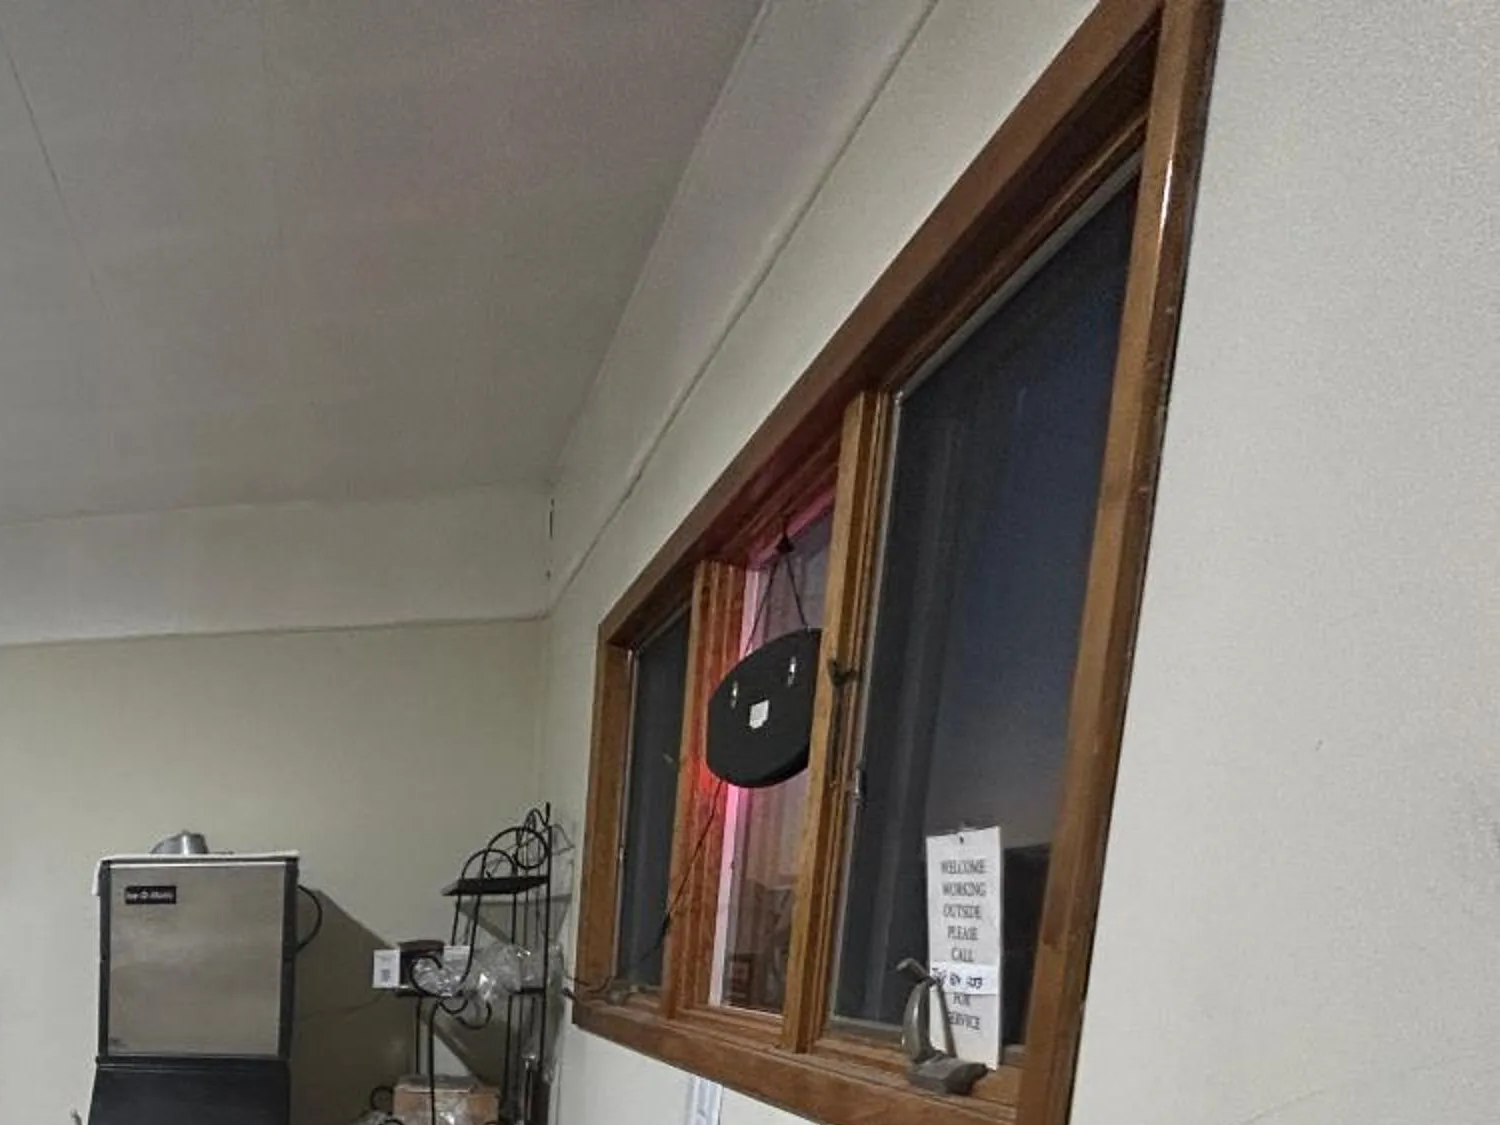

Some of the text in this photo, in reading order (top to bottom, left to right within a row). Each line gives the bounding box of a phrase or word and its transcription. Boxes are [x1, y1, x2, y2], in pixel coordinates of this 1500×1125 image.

[941, 859, 986, 875] WELCOME
[942, 881, 987, 897] WORKING
[943, 903, 982, 919] OUTSIDE
[947, 925, 978, 941] PLEASE
[951, 947, 974, 963] CALL
[947, 1011, 981, 1031] ERVICE
